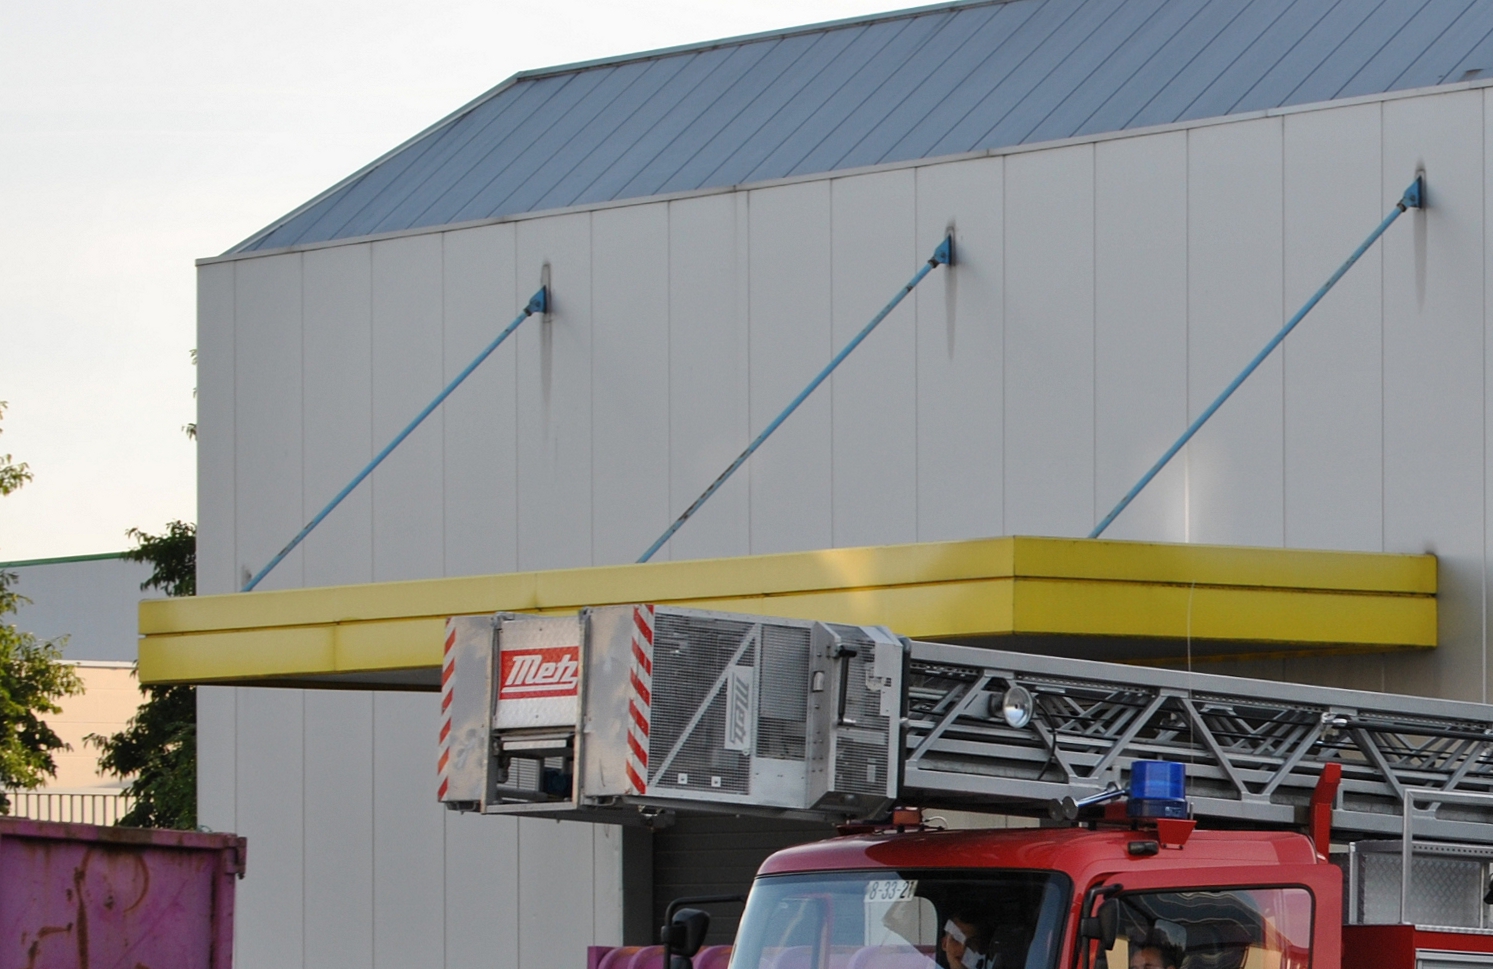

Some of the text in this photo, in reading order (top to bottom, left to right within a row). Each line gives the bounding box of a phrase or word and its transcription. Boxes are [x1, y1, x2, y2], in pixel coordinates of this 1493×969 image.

[502, 654, 578, 693] Metz
[730, 672, 750, 745] Metz
[869, 881, 915, 900] 8-33-21
